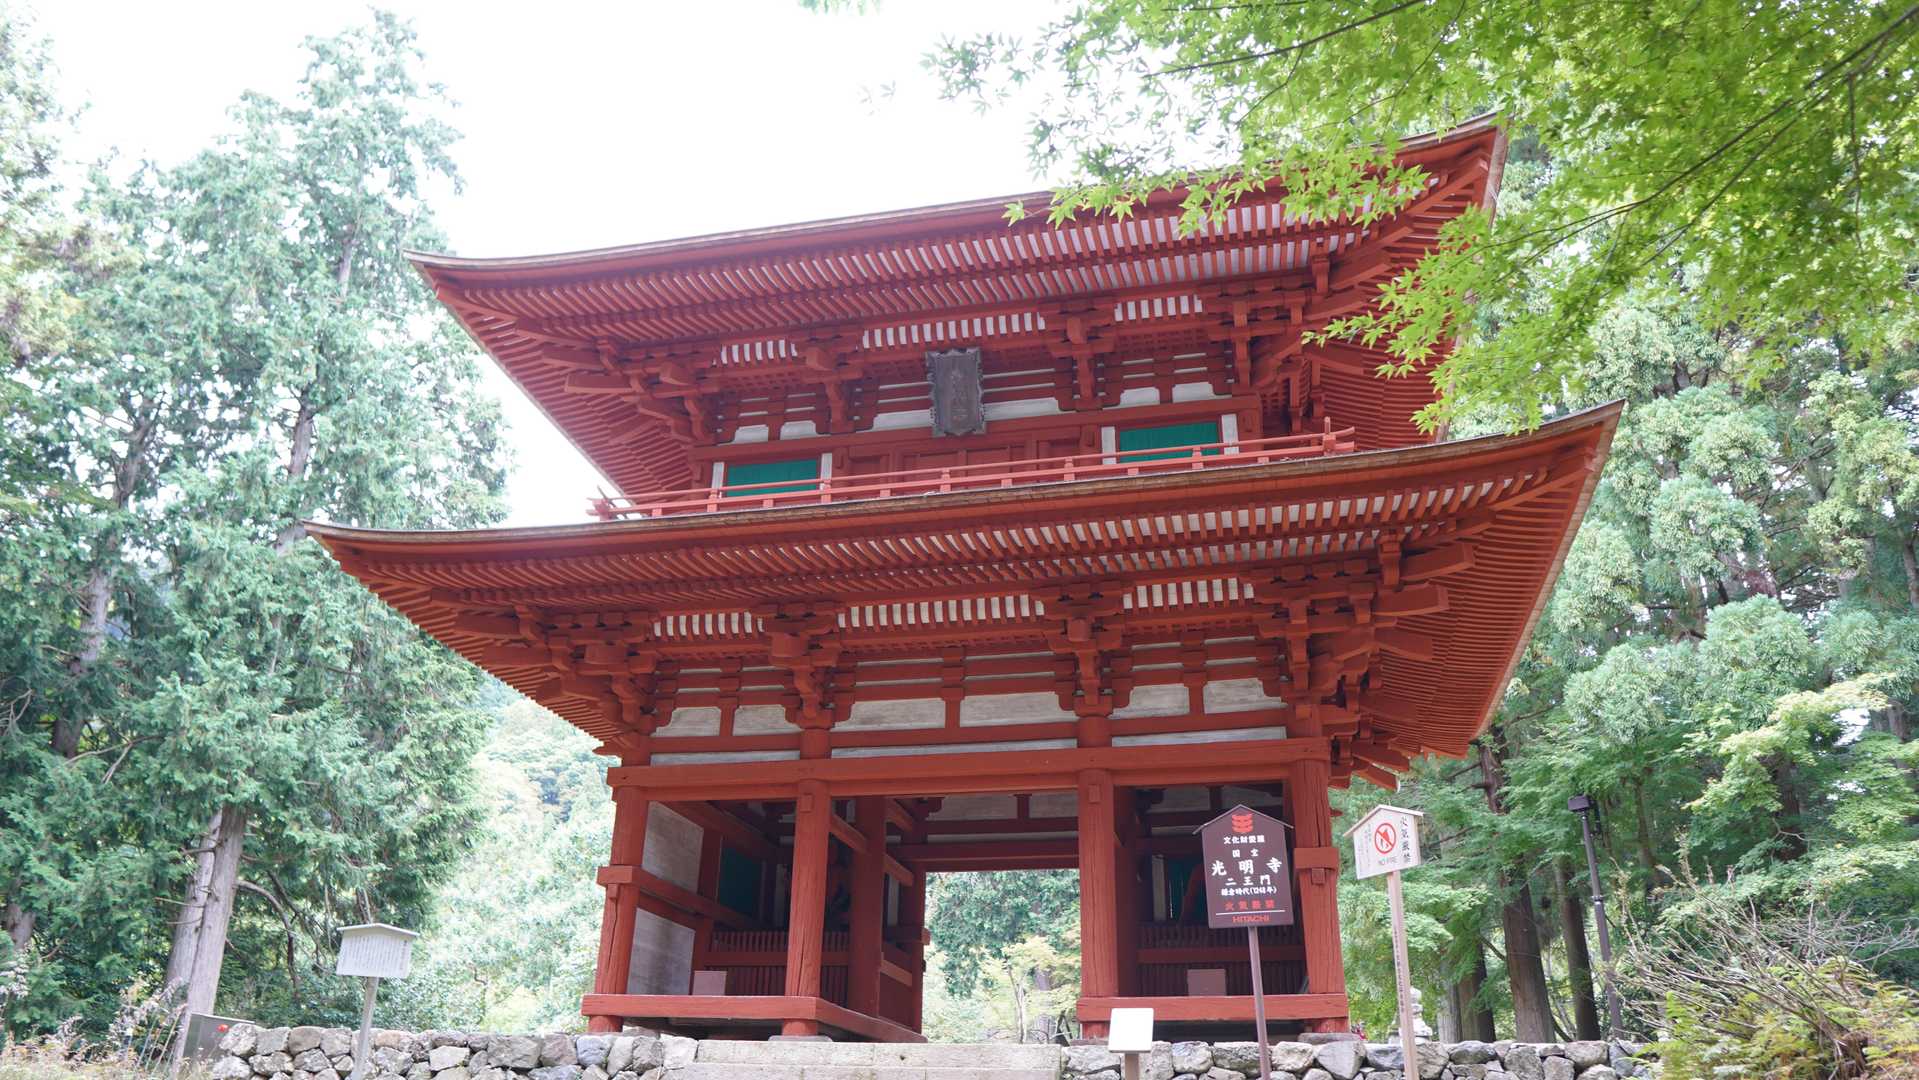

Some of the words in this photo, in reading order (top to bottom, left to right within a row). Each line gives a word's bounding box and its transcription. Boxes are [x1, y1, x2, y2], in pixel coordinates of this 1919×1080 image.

[1232, 848, 1259, 858] 国宝
[1211, 857, 1282, 876] 光明寺
[1225, 875, 1271, 886] 二王門
[1232, 915, 1270, 923] HITACHI
